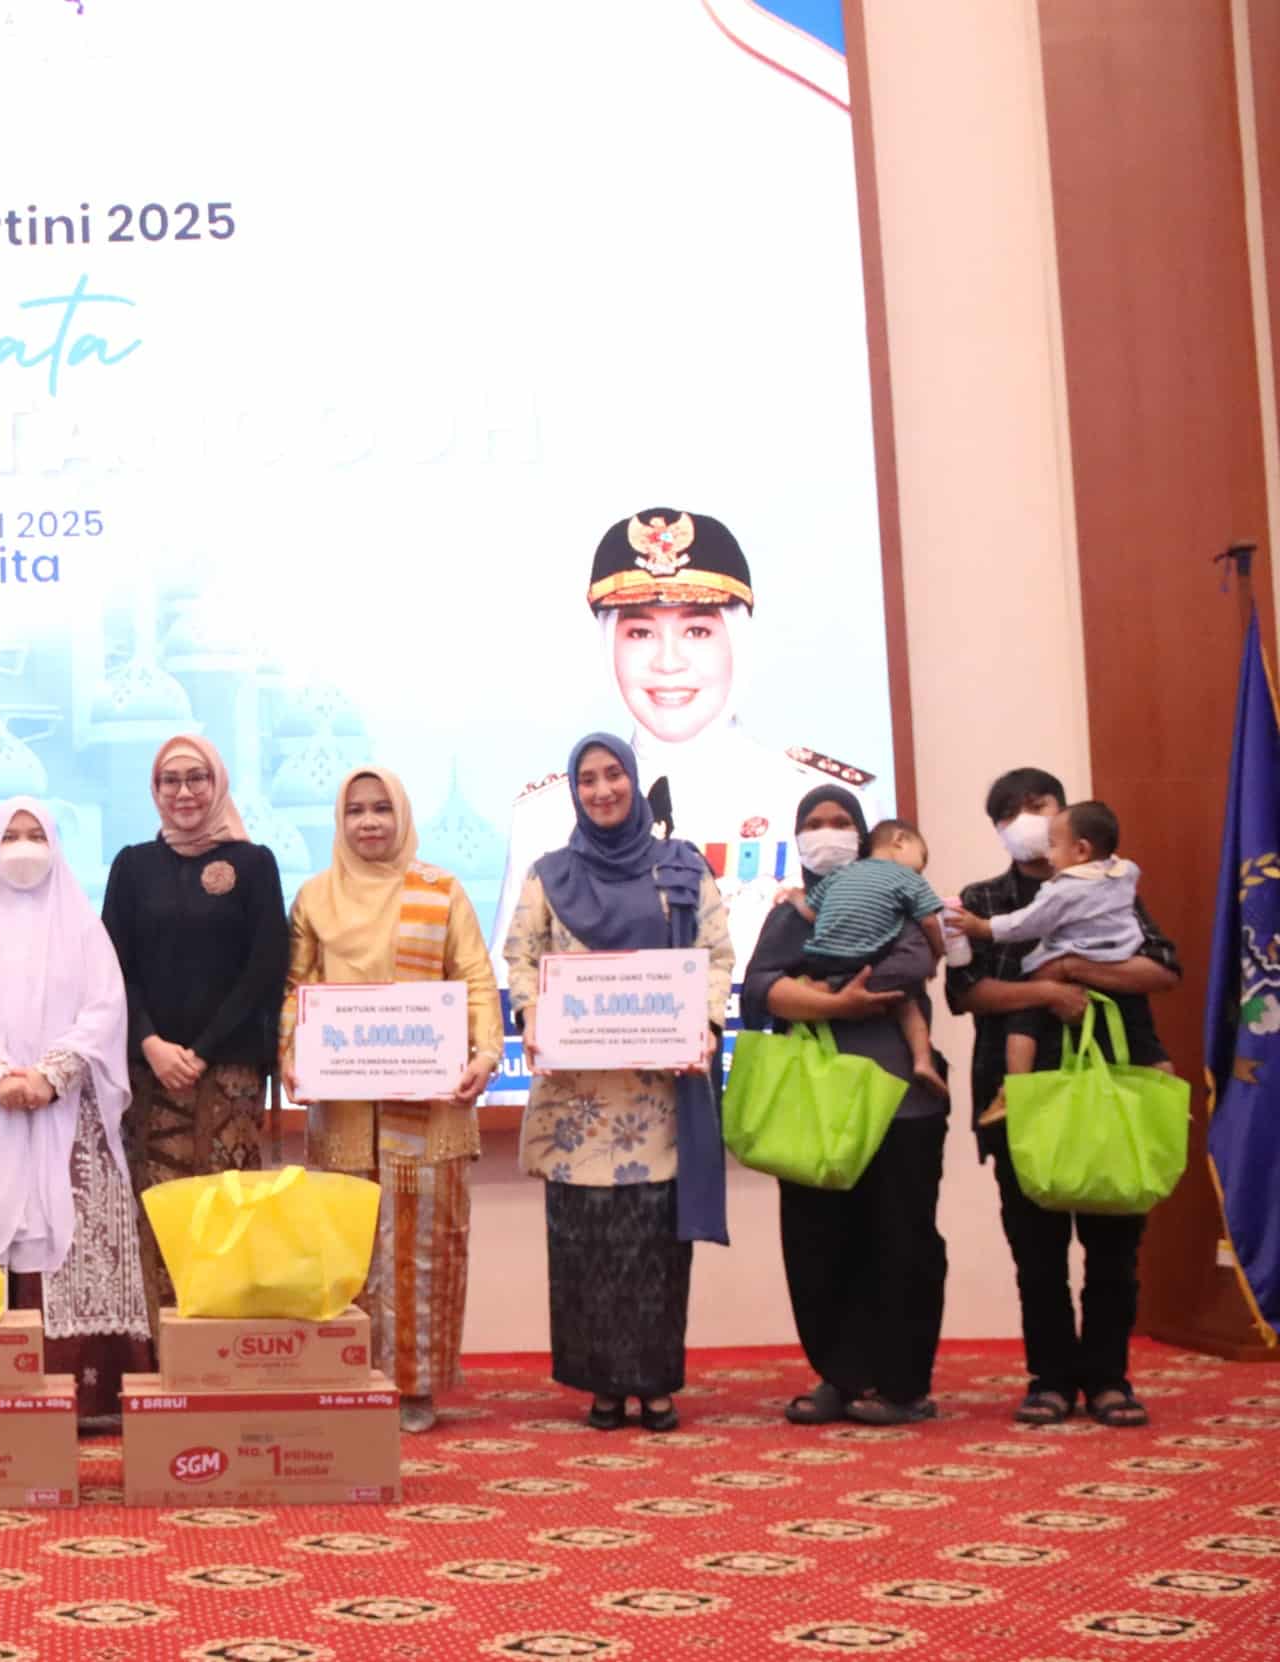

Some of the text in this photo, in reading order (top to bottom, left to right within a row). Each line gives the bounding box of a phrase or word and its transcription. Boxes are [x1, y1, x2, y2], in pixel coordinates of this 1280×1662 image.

[107, 202, 237, 243] 2025
[17, 510, 104, 538] 2025
[576, 974, 616, 983] BANTUAN
[646, 973, 672, 981] TUNAI
[336, 1005, 376, 1013] BANTUAN
[405, 1005, 431, 1013] TUNAI
[241, 1337, 294, 1355] SUN
[176, 1452, 220, 1476] SGM
[266, 1445, 282, 1476] 1
